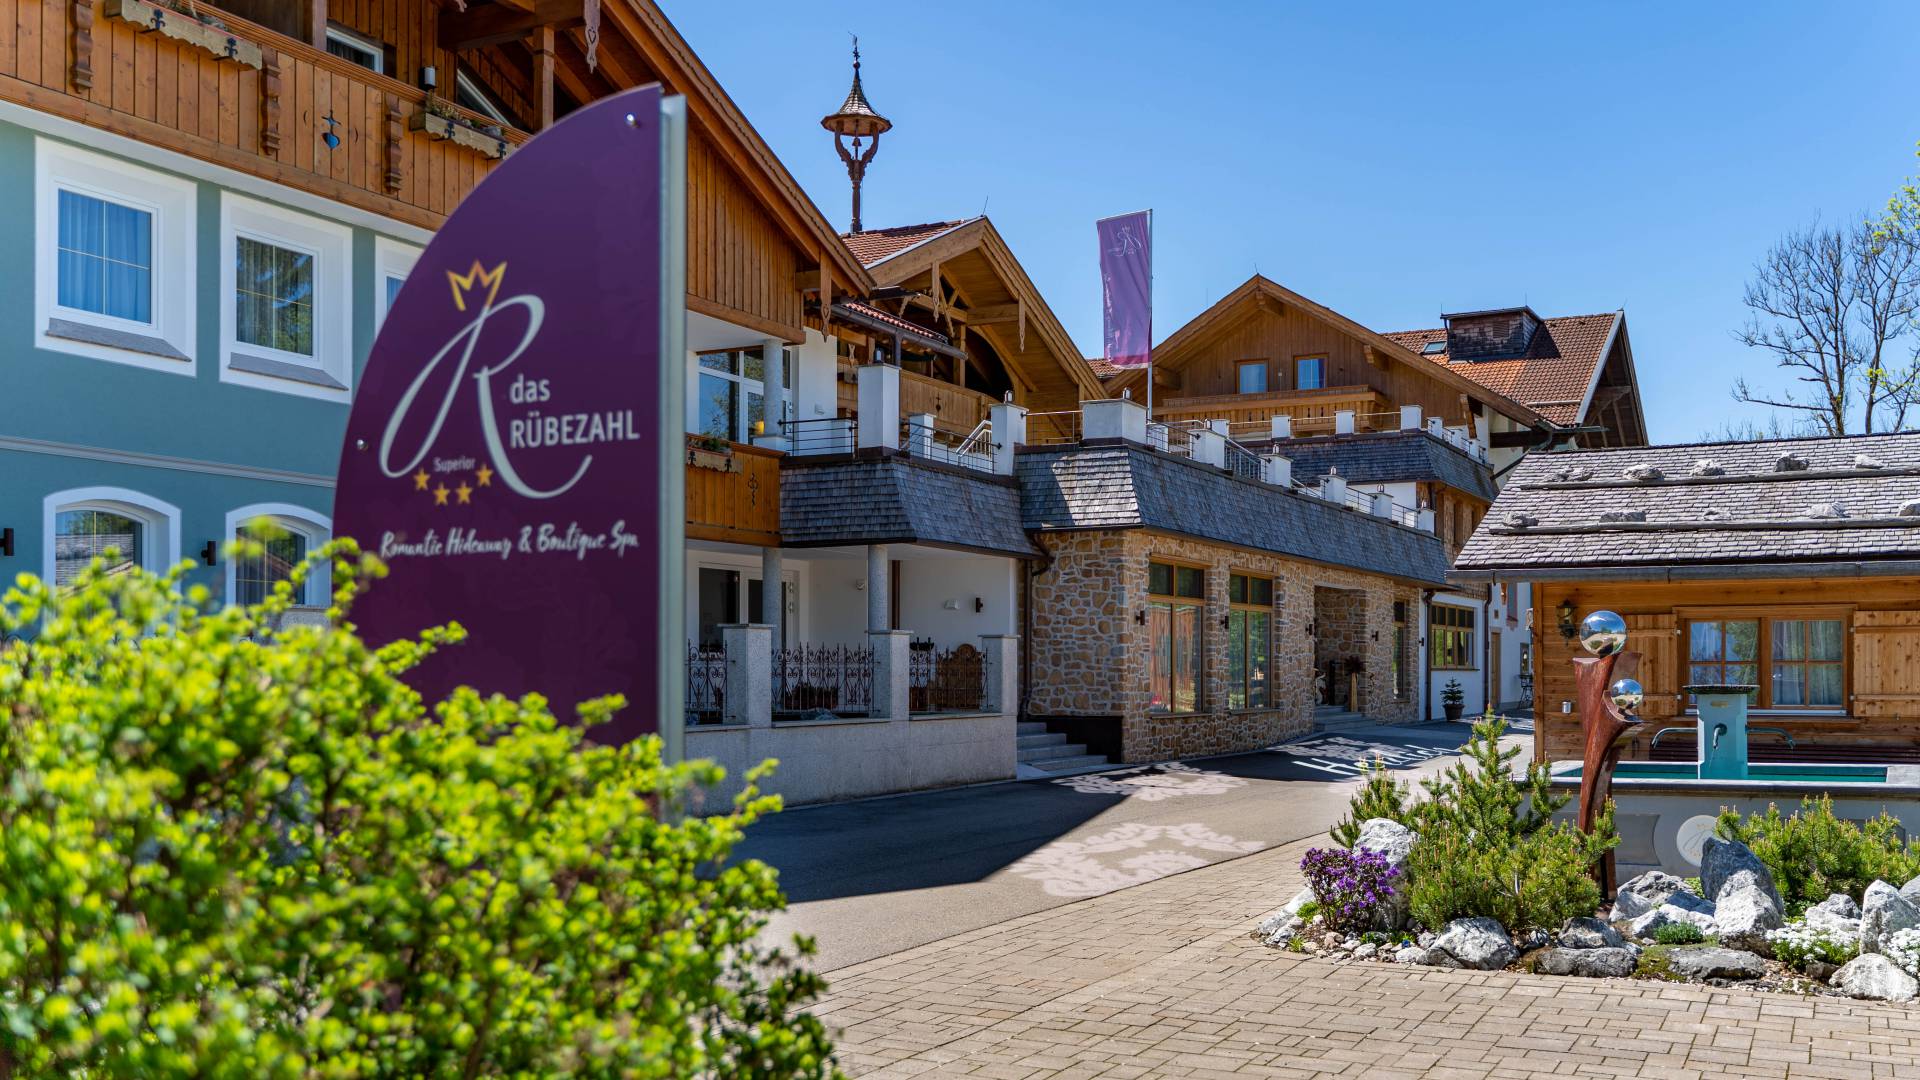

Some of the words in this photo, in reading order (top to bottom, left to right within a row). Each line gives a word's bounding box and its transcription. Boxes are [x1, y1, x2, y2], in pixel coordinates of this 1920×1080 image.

[509, 373, 551, 405] das
[509, 409, 641, 449] RÜBEZAHL
[433, 456, 476, 473] Superior
[380, 530, 443, 558] Romantic
[446, 527, 512, 560] Hideaway
[518, 525, 533, 553] &
[536, 522, 606, 561] Boutique
[609, 519, 640, 557] Spa
